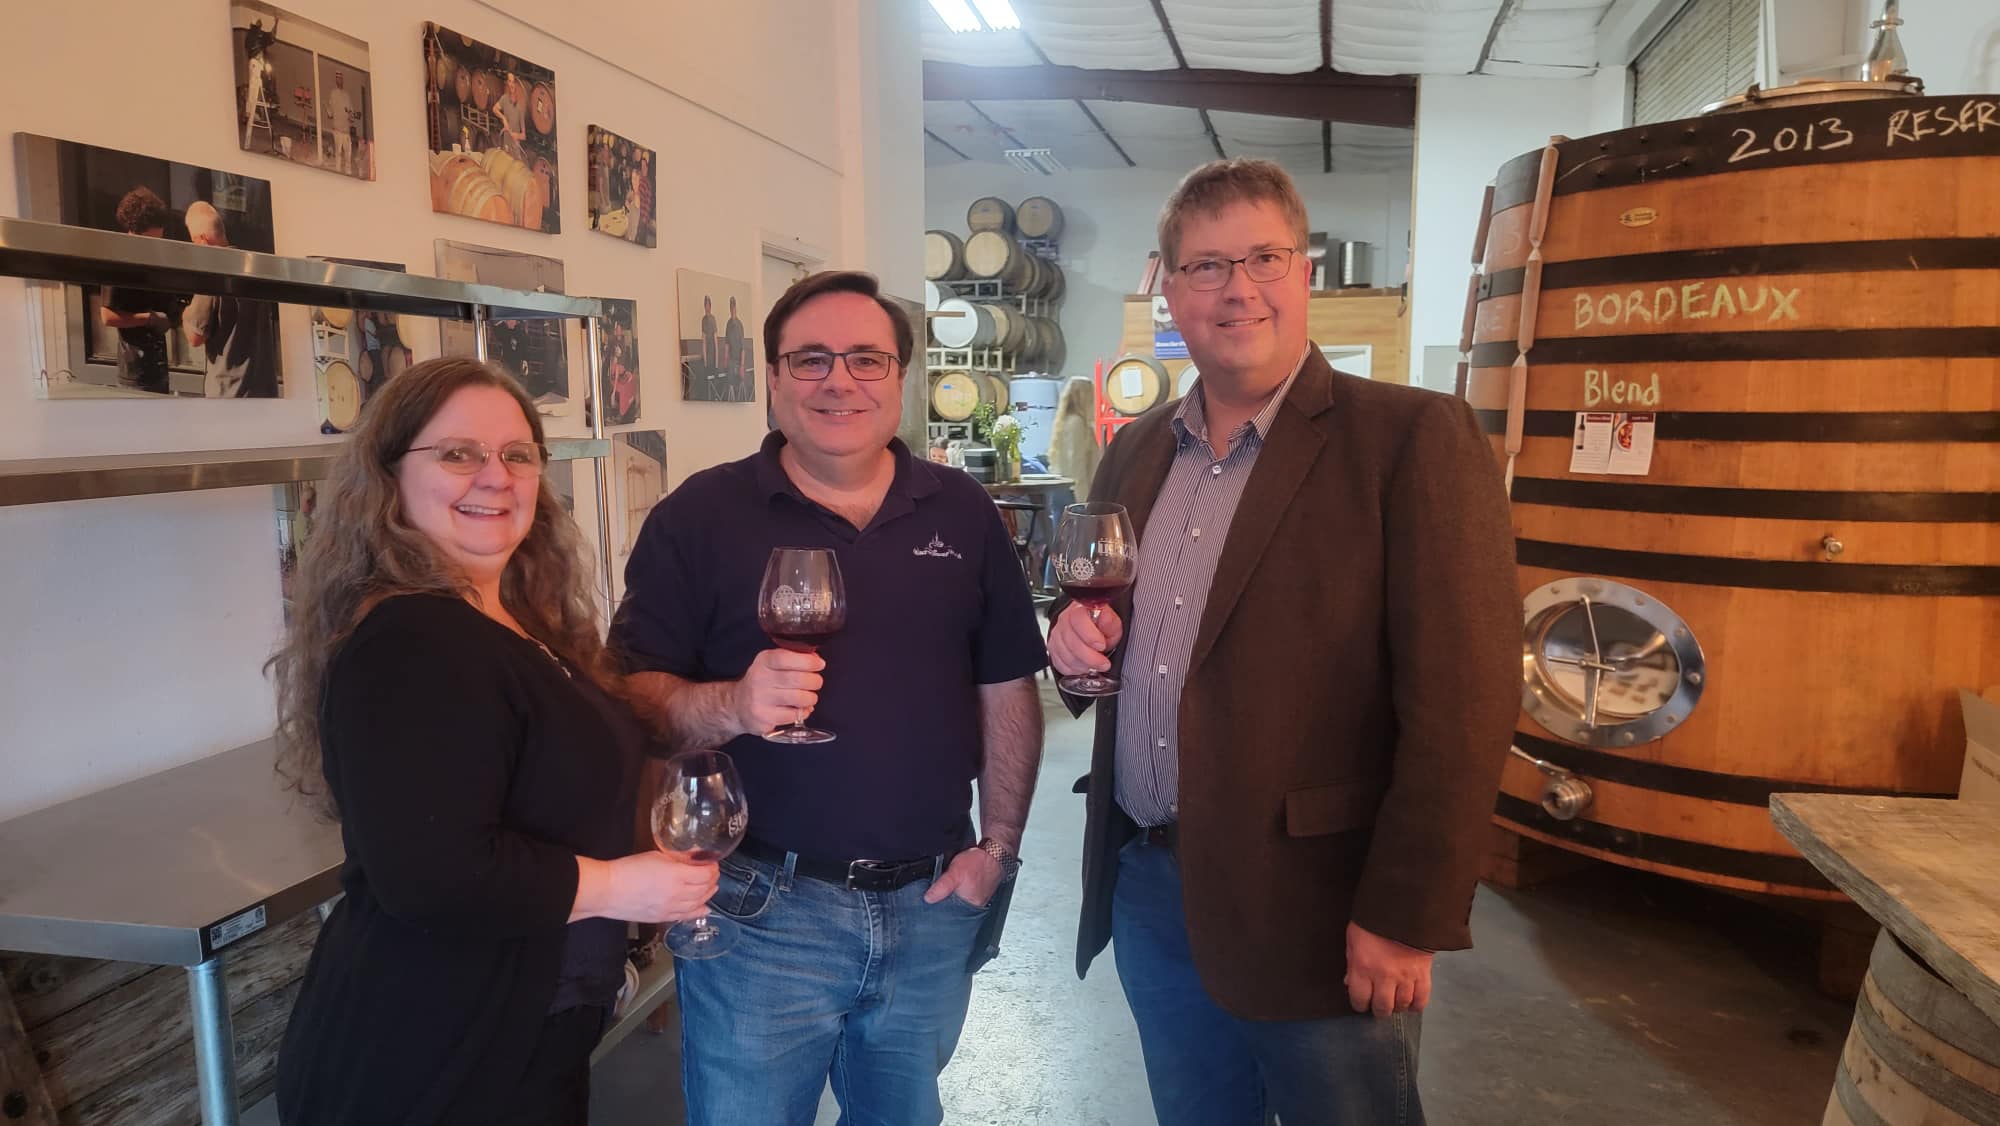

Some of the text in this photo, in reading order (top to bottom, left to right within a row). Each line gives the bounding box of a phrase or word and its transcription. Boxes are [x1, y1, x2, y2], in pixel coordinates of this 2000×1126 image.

[1728, 117, 1853, 163] 2013
[1575, 282, 1800, 330] BORDEAUX
[1584, 369, 1660, 406] Blend
